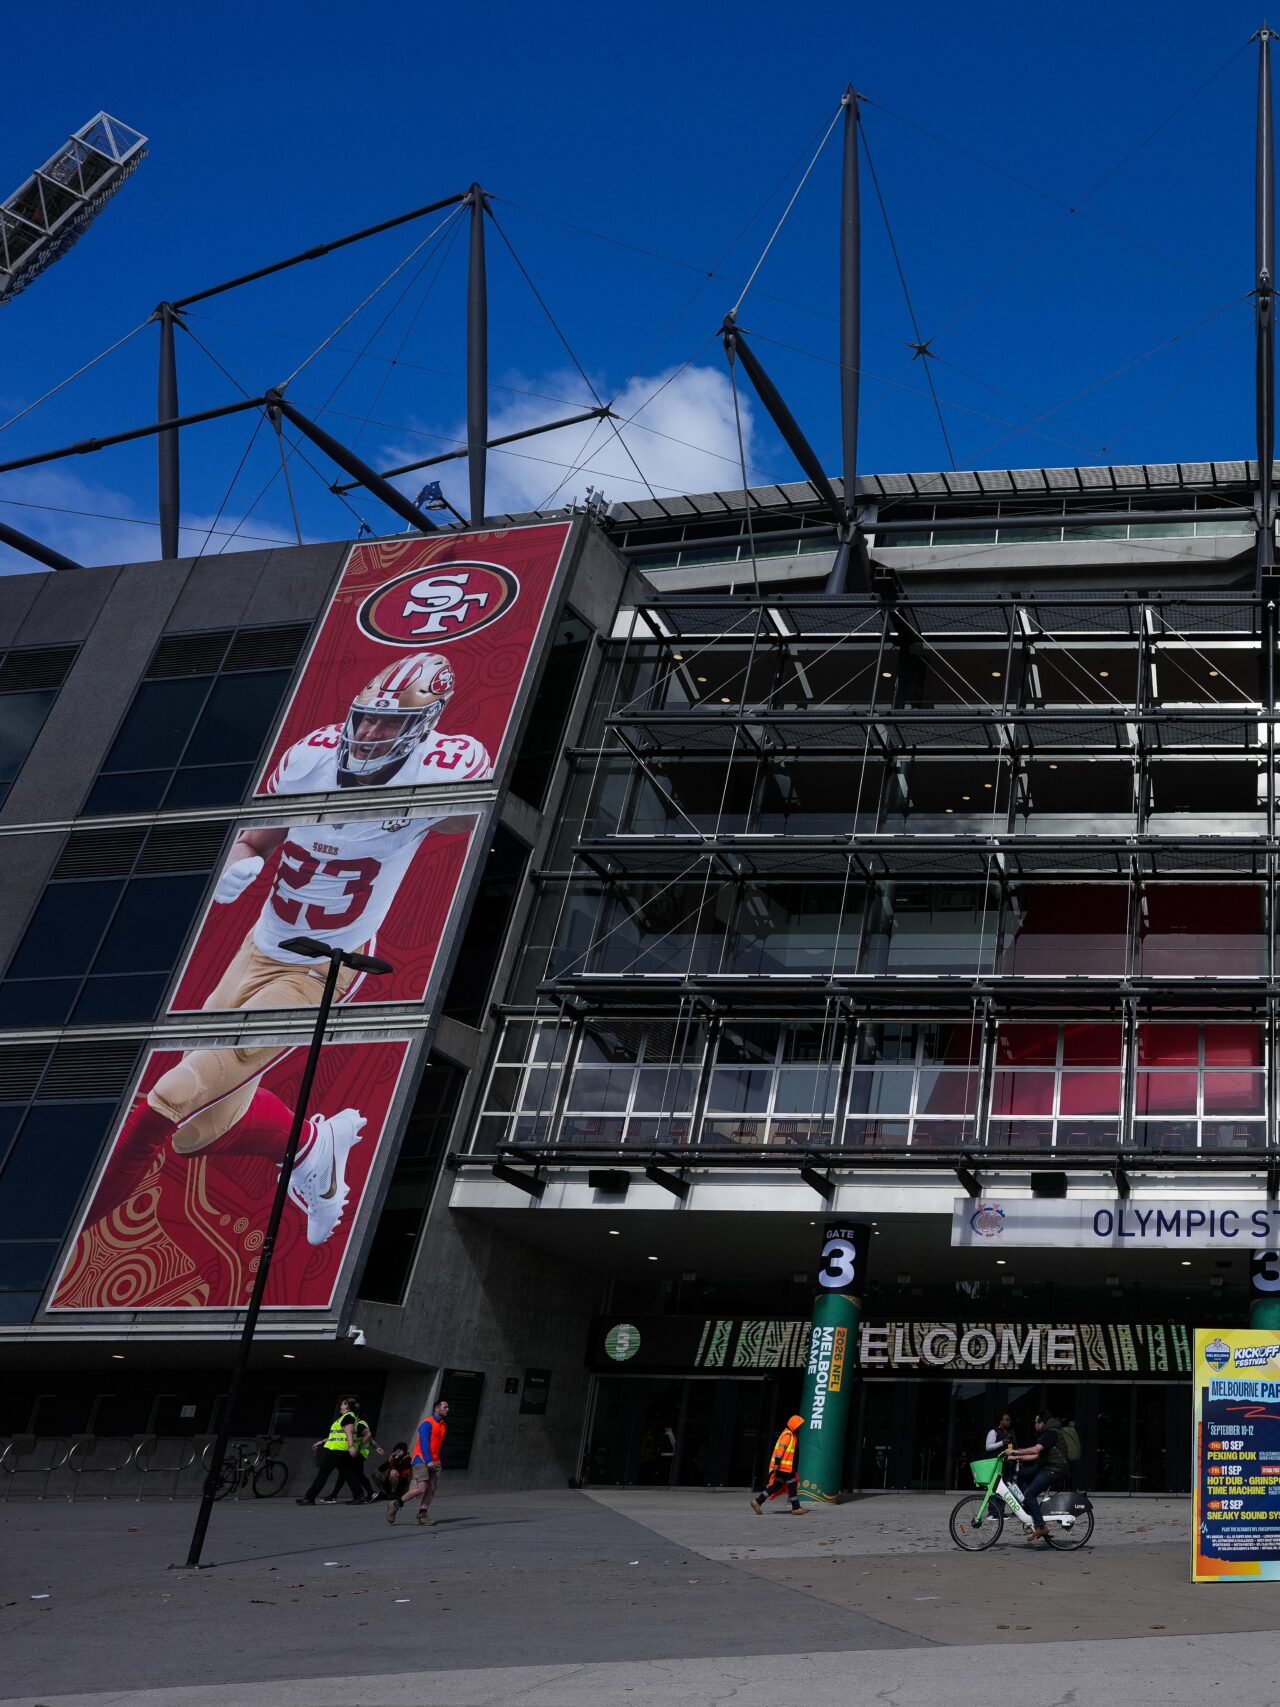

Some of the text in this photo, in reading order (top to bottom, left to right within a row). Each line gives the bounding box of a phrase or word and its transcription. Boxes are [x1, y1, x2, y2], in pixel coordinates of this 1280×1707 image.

[402, 574, 488, 634] SF
[422, 738, 470, 770] 23
[313, 842, 339, 855] 49ERS
[270, 841, 382, 930] 23
[1092, 1210, 1240, 1238] OLYMPIC
[826, 1229, 855, 1238] GATE
[818, 1238, 856, 1288] 3
[808, 1326, 822, 1375] GAME
[860, 1328, 1076, 1365] ELCOME
[1235, 1345, 1280, 1360] KICKOFF
[830, 1331, 846, 1388] 2026 NFL
[1236, 1358, 1267, 1367] FESTIVAL
[810, 1326, 834, 1430] MELBOURNE
[1212, 1382, 1258, 1397] MELBOURNE
[1211, 1425, 1240, 1435] SEPTEMBER
[1222, 1441, 1229, 1450] 10
[1230, 1441, 1244, 1450] SEP
[1208, 1452, 1237, 1460] PEKING
[1239, 1452, 1256, 1460] DUK
[1221, 1466, 1227, 1475] 11
[1228, 1466, 1242, 1475] SEP
[1207, 1486, 1228, 1494] TIME
[1229, 1486, 1266, 1494] MACHINE
[1221, 1500, 1228, 1509] 12
[1230, 1500, 1243, 1509] SEP
[1207, 1512, 1239, 1520] SNEAKY
[1241, 1512, 1267, 1520] SOUND
